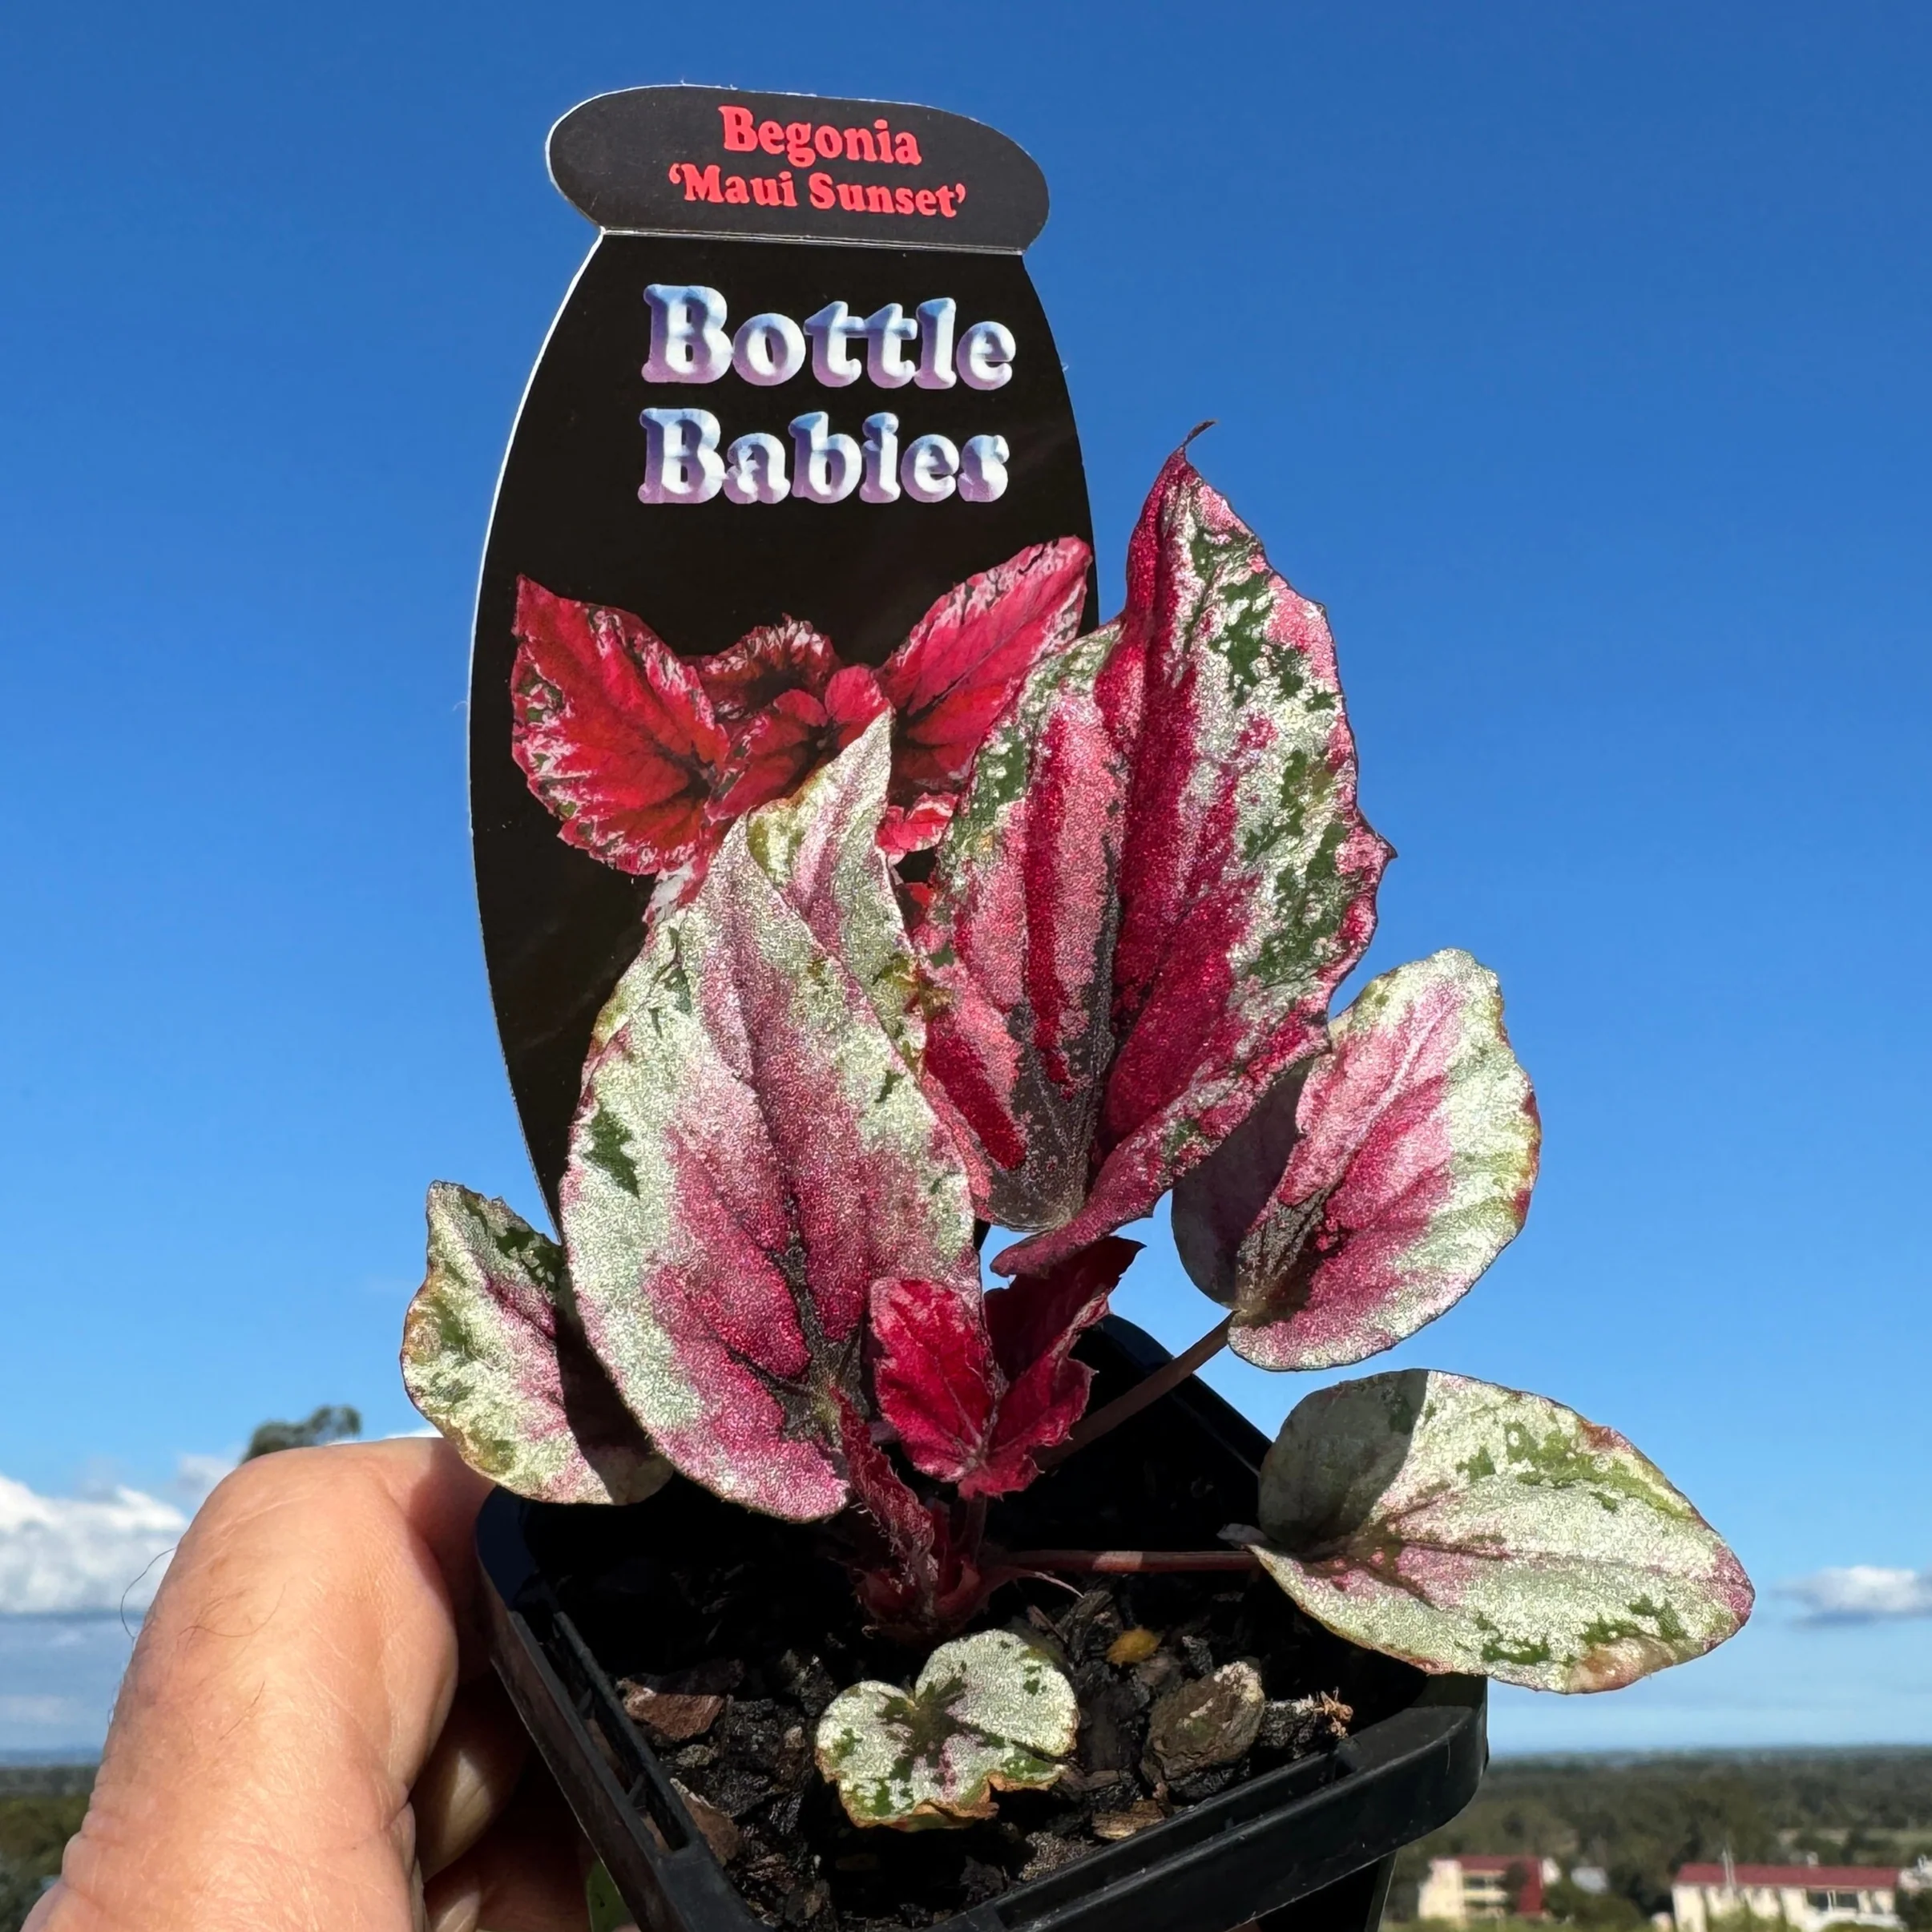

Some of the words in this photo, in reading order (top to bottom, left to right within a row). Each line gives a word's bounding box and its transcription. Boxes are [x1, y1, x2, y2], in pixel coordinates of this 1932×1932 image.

[719, 106, 922, 167] Begonia
[668, 163, 798, 208] ‘Maui
[808, 172, 966, 217] Sunset’
[641, 284, 1016, 390] Bottle
[638, 408, 1010, 504] Babies
